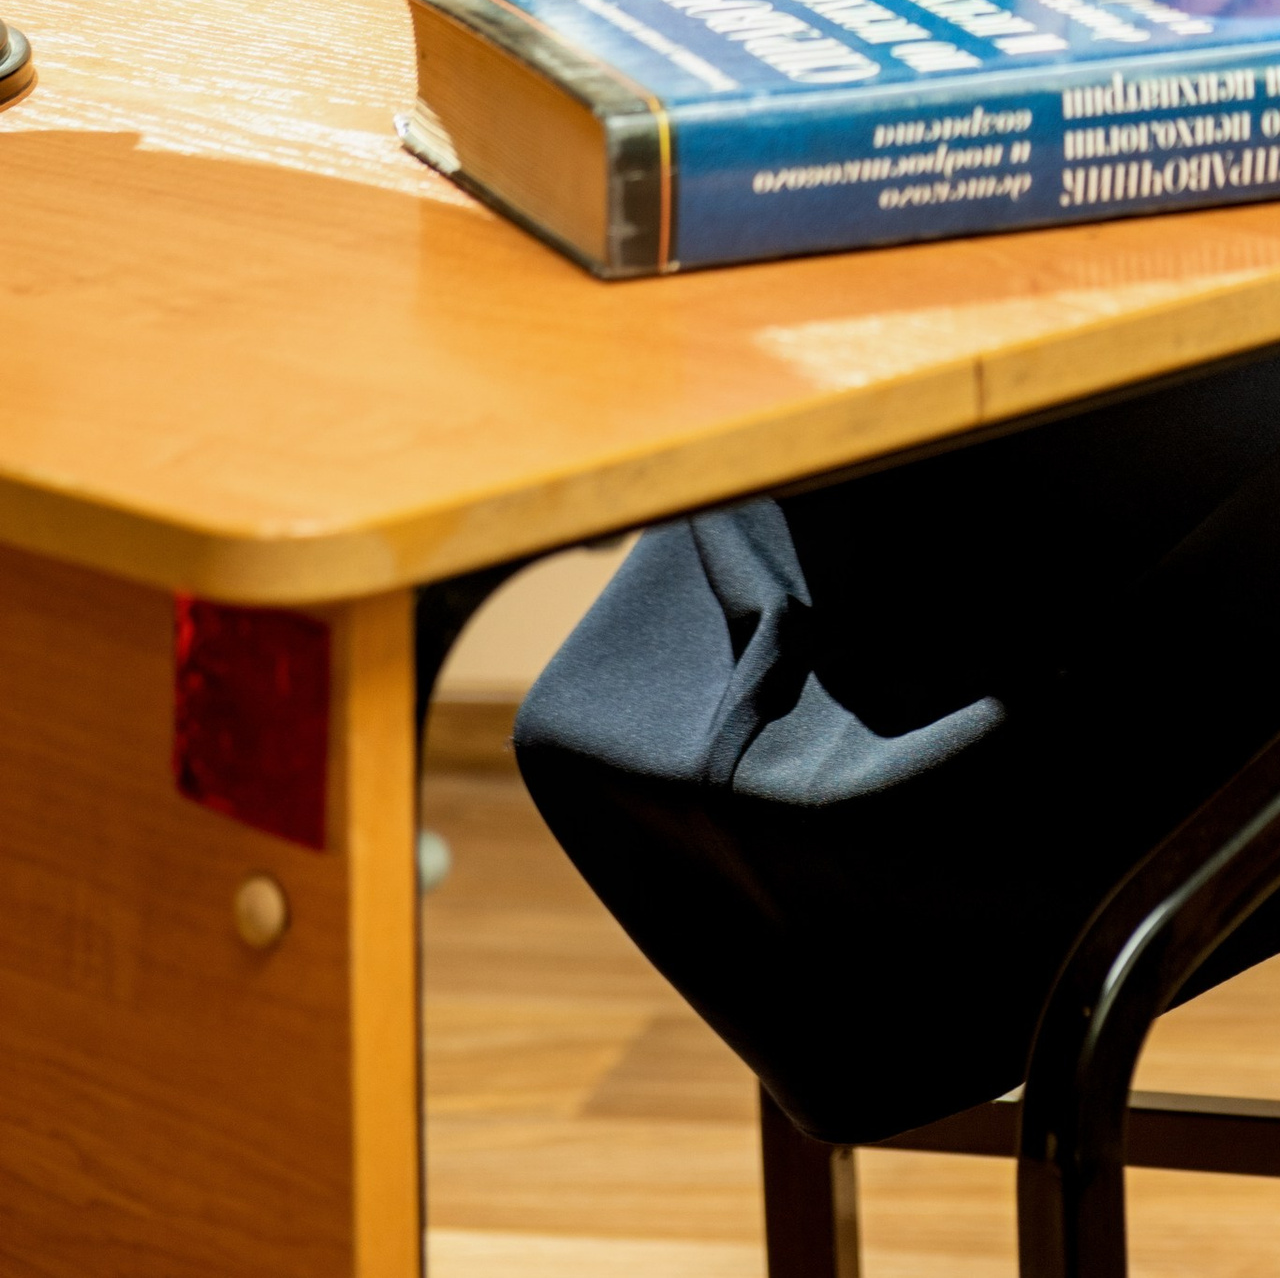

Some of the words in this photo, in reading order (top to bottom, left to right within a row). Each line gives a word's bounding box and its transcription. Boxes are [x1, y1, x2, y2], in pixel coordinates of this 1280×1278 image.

[1061, 69, 1256, 120] психиатрии
[872, 105, 1033, 149] возраста
[1063, 120, 1252, 161] психологии
[752, 142, 1004, 194] подросткового
[1009, 140, 1032, 165] и
[878, 172, 1032, 210] детского
